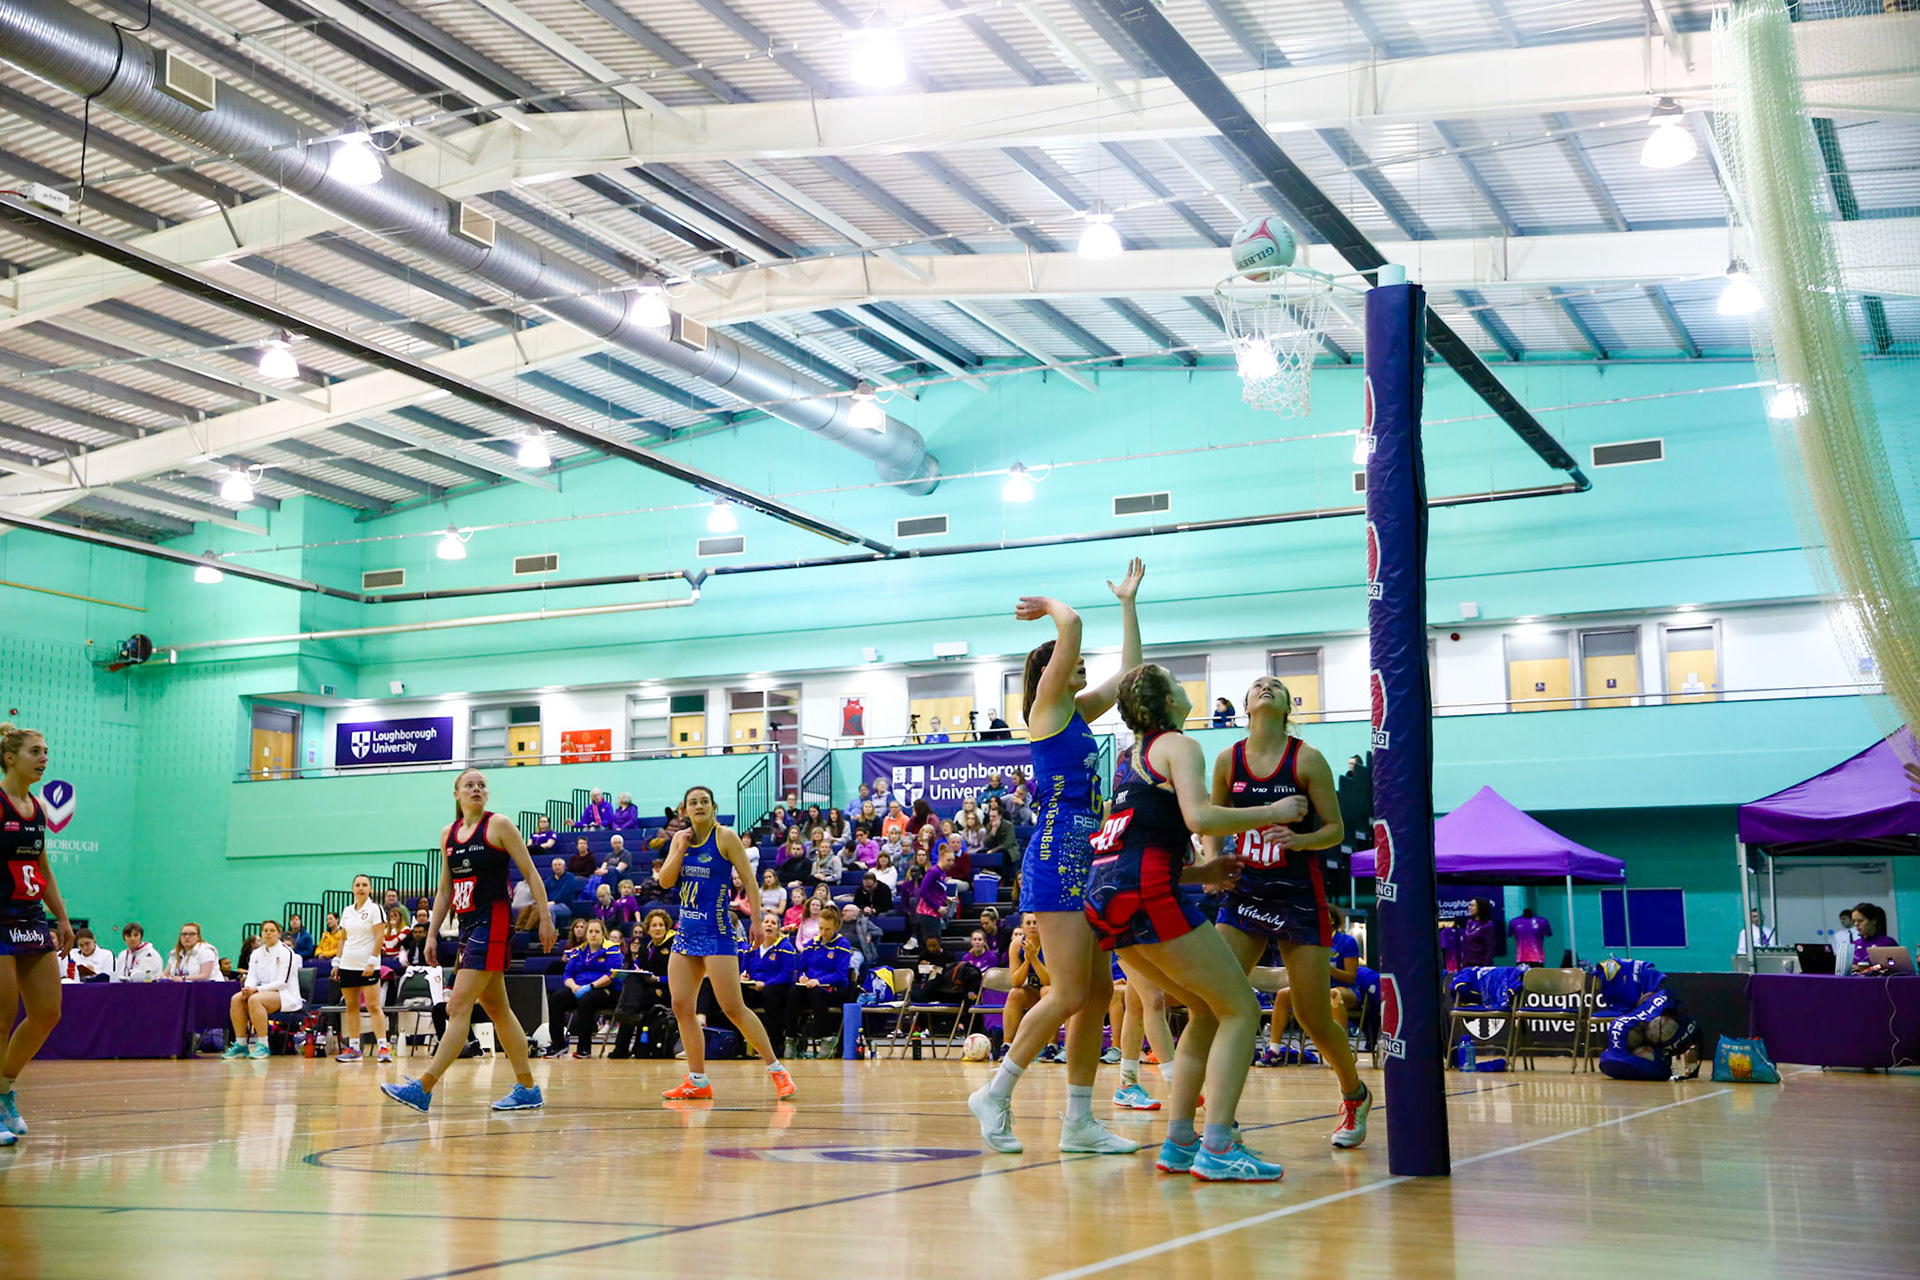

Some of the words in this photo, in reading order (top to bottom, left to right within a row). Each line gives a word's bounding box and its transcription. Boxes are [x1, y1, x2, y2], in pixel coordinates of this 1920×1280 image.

[372, 728, 438, 742] Loughborough
[372, 741, 418, 754] University
[46, 838, 99, 852] BOROUGH
[21, 864, 41, 897] C
[1237, 903, 1286, 931] Vitality
[9, 926, 45, 946] Vitality
